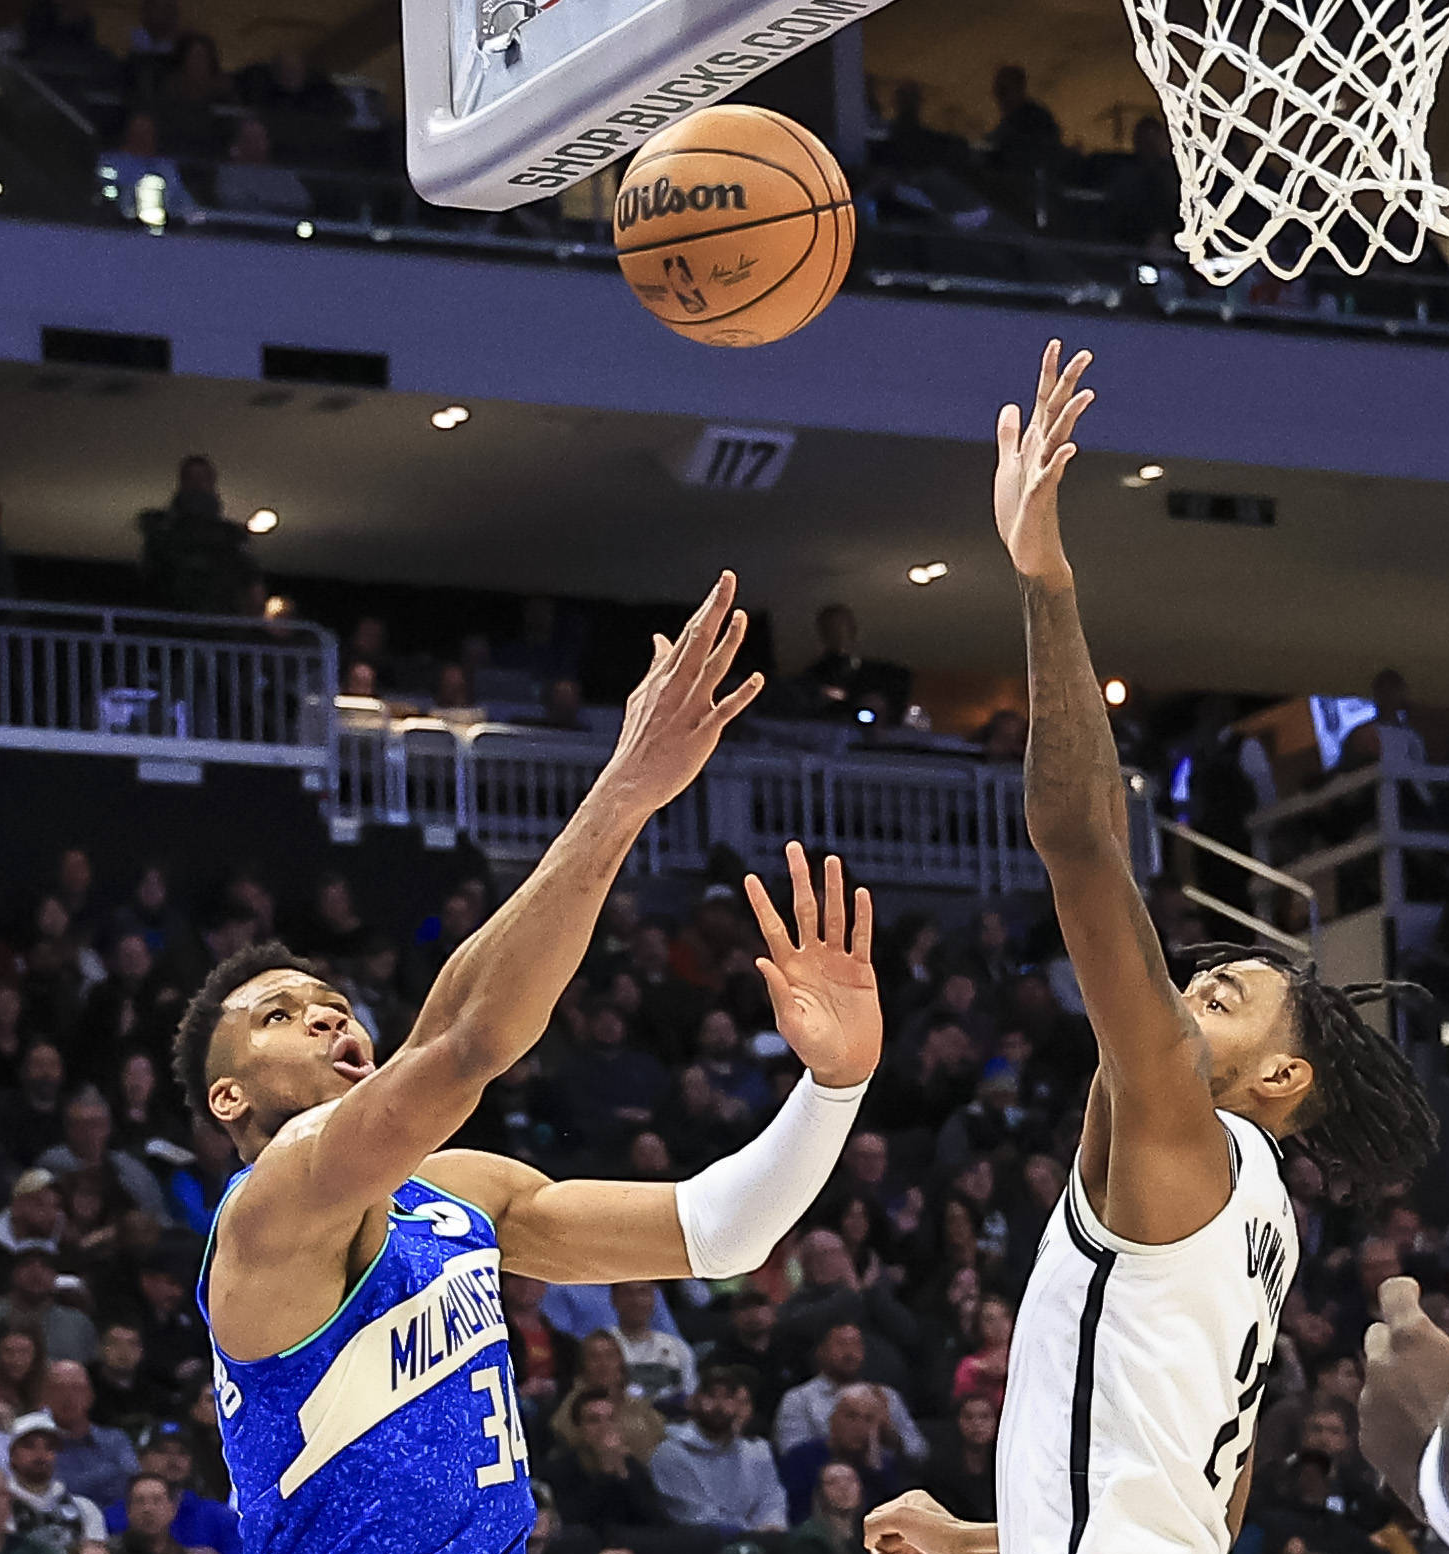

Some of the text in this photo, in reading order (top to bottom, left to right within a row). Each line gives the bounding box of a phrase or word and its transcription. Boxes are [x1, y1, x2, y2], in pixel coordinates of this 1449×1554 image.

[507, 0, 868, 190] SHOP.BUCKS.COM
[617, 177, 747, 232] Wilson
[707, 440, 778, 484] 117
